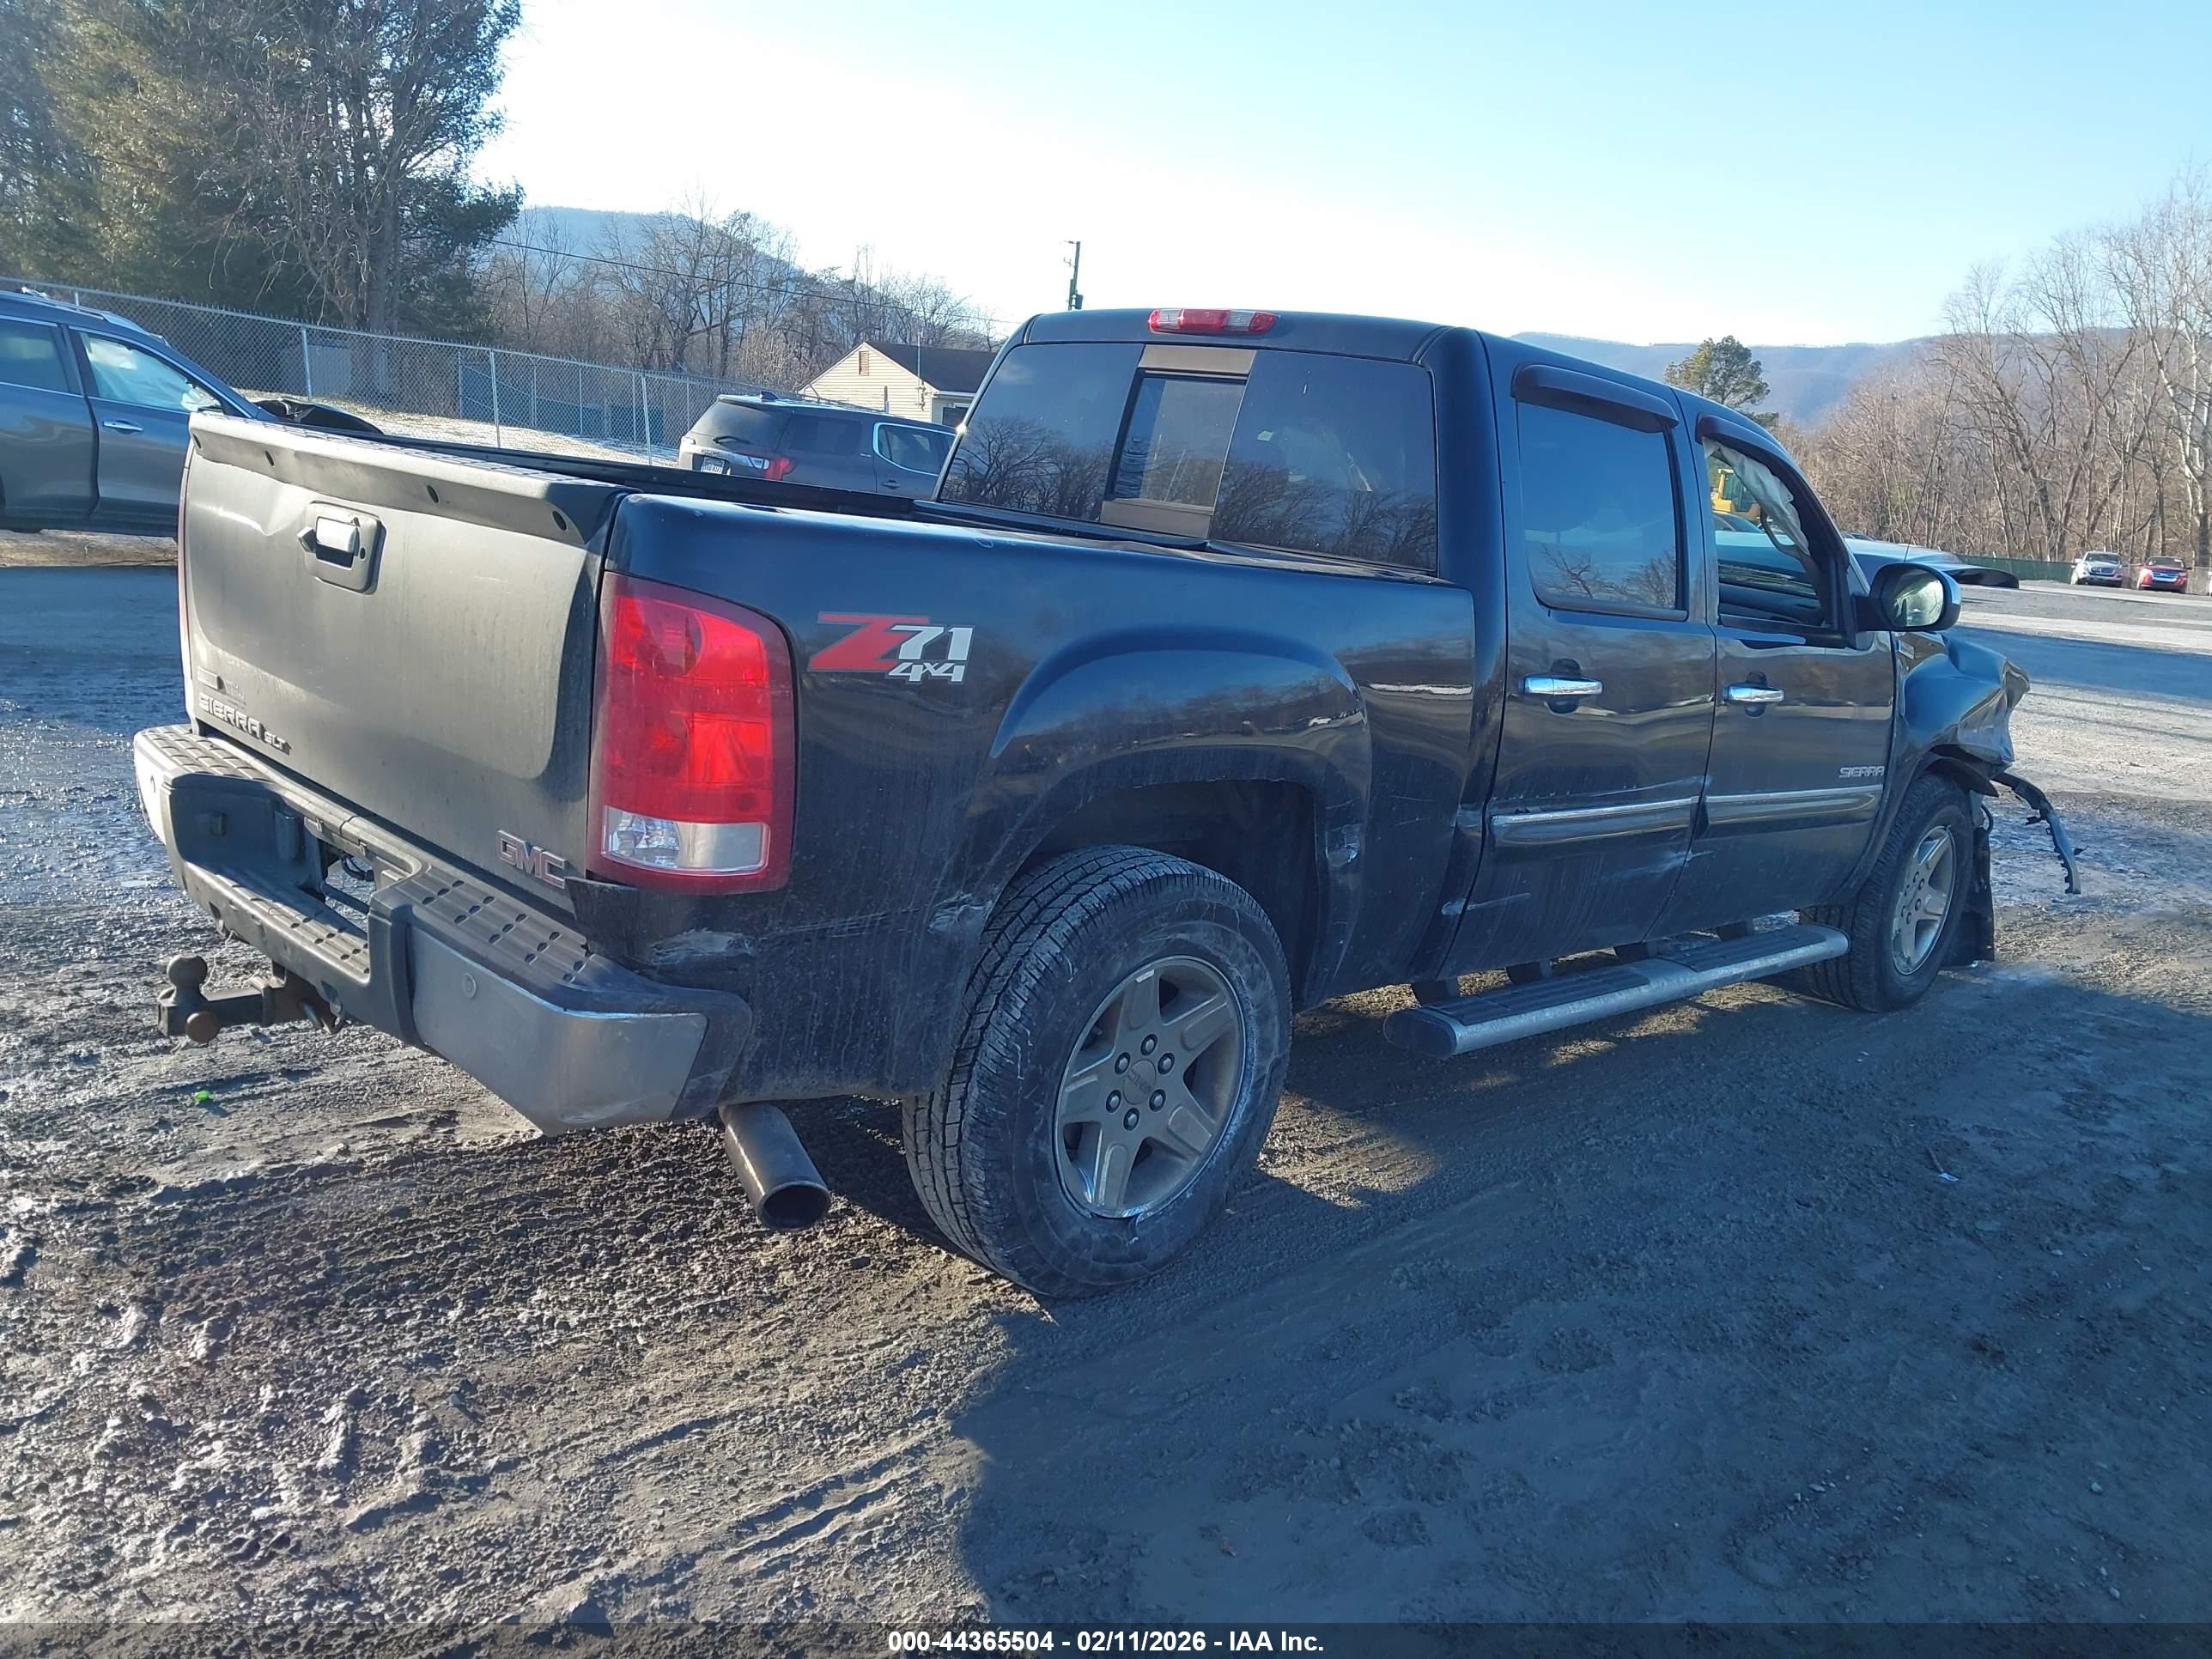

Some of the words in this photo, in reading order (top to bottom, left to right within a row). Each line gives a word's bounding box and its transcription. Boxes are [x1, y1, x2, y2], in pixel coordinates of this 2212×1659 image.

[808, 611, 975, 672] Z71
[198, 691, 261, 740] SIERRA
[264, 731, 289, 751] SLT
[1838, 765, 1886, 778] SIERRA
[495, 830, 566, 890] GMC
